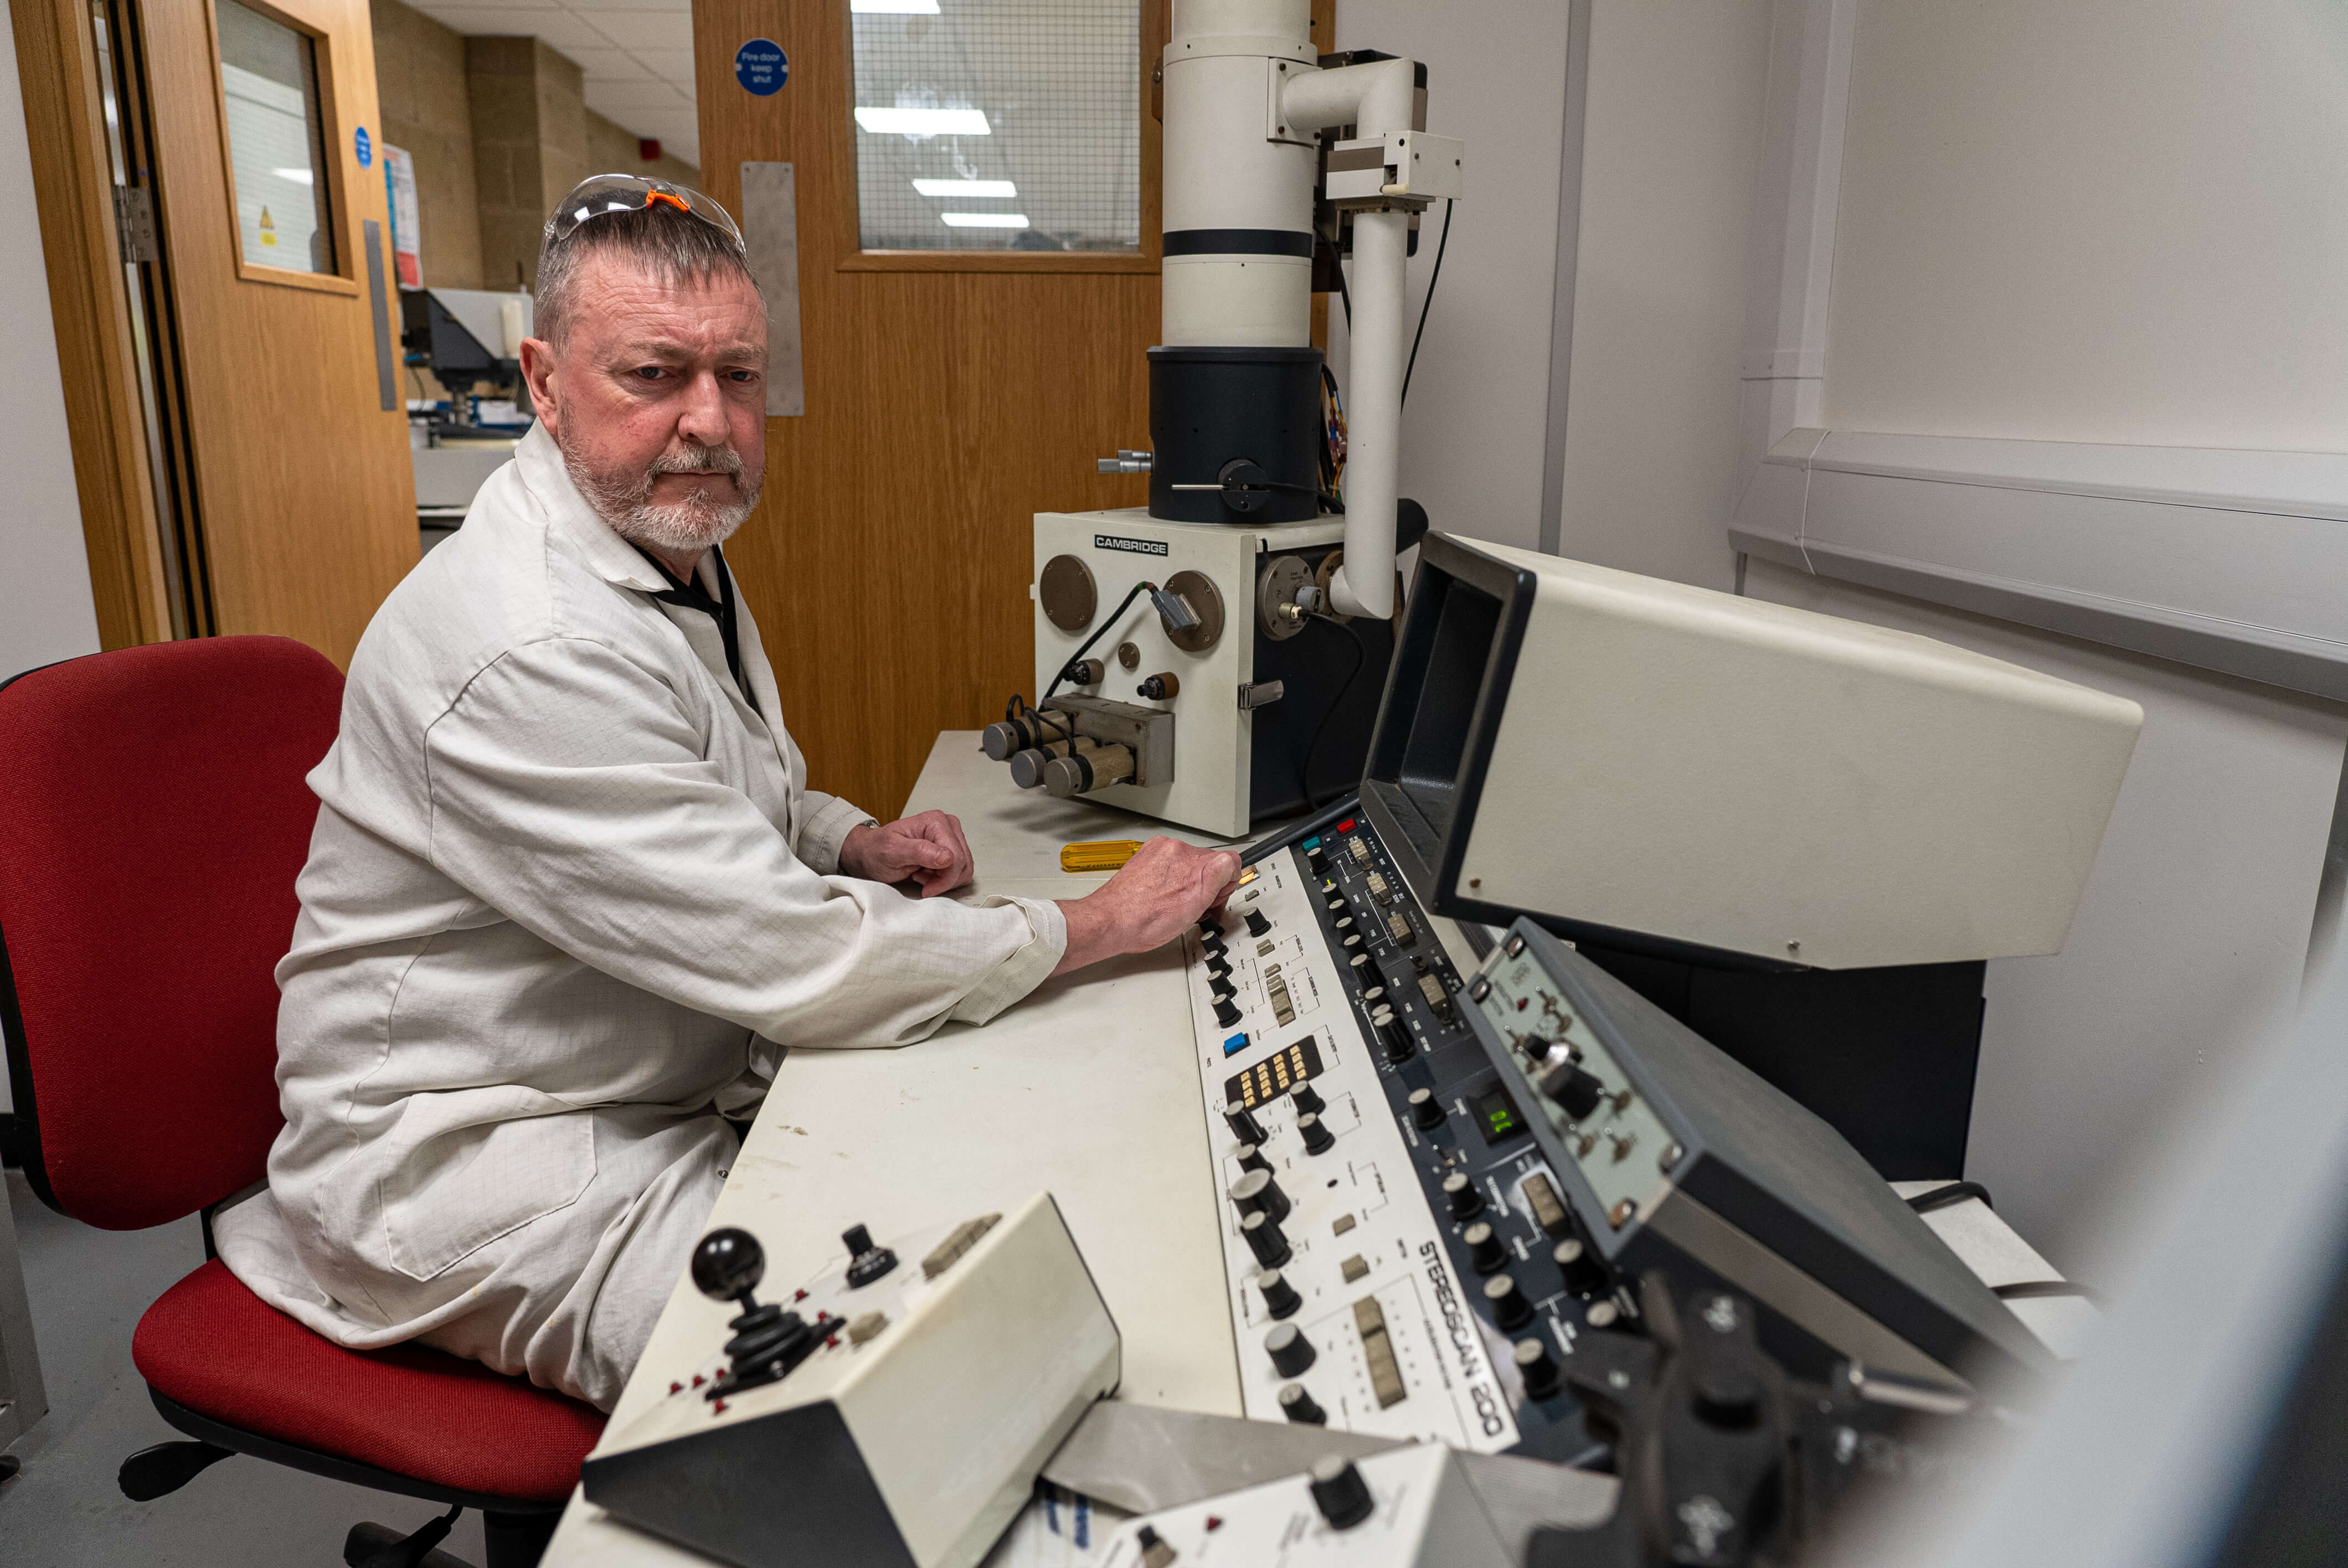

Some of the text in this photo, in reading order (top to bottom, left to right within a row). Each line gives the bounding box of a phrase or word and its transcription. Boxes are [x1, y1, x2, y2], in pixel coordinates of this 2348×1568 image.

[742, 52, 780, 61] Fire door
[751, 64, 772, 73] keep
[753, 75, 771, 84] shut
[1096, 537, 1167, 554] CAMBRIDGE
[1419, 1240, 1482, 1378] STEREOSCAN
[1471, 1382, 1503, 1437] 200
